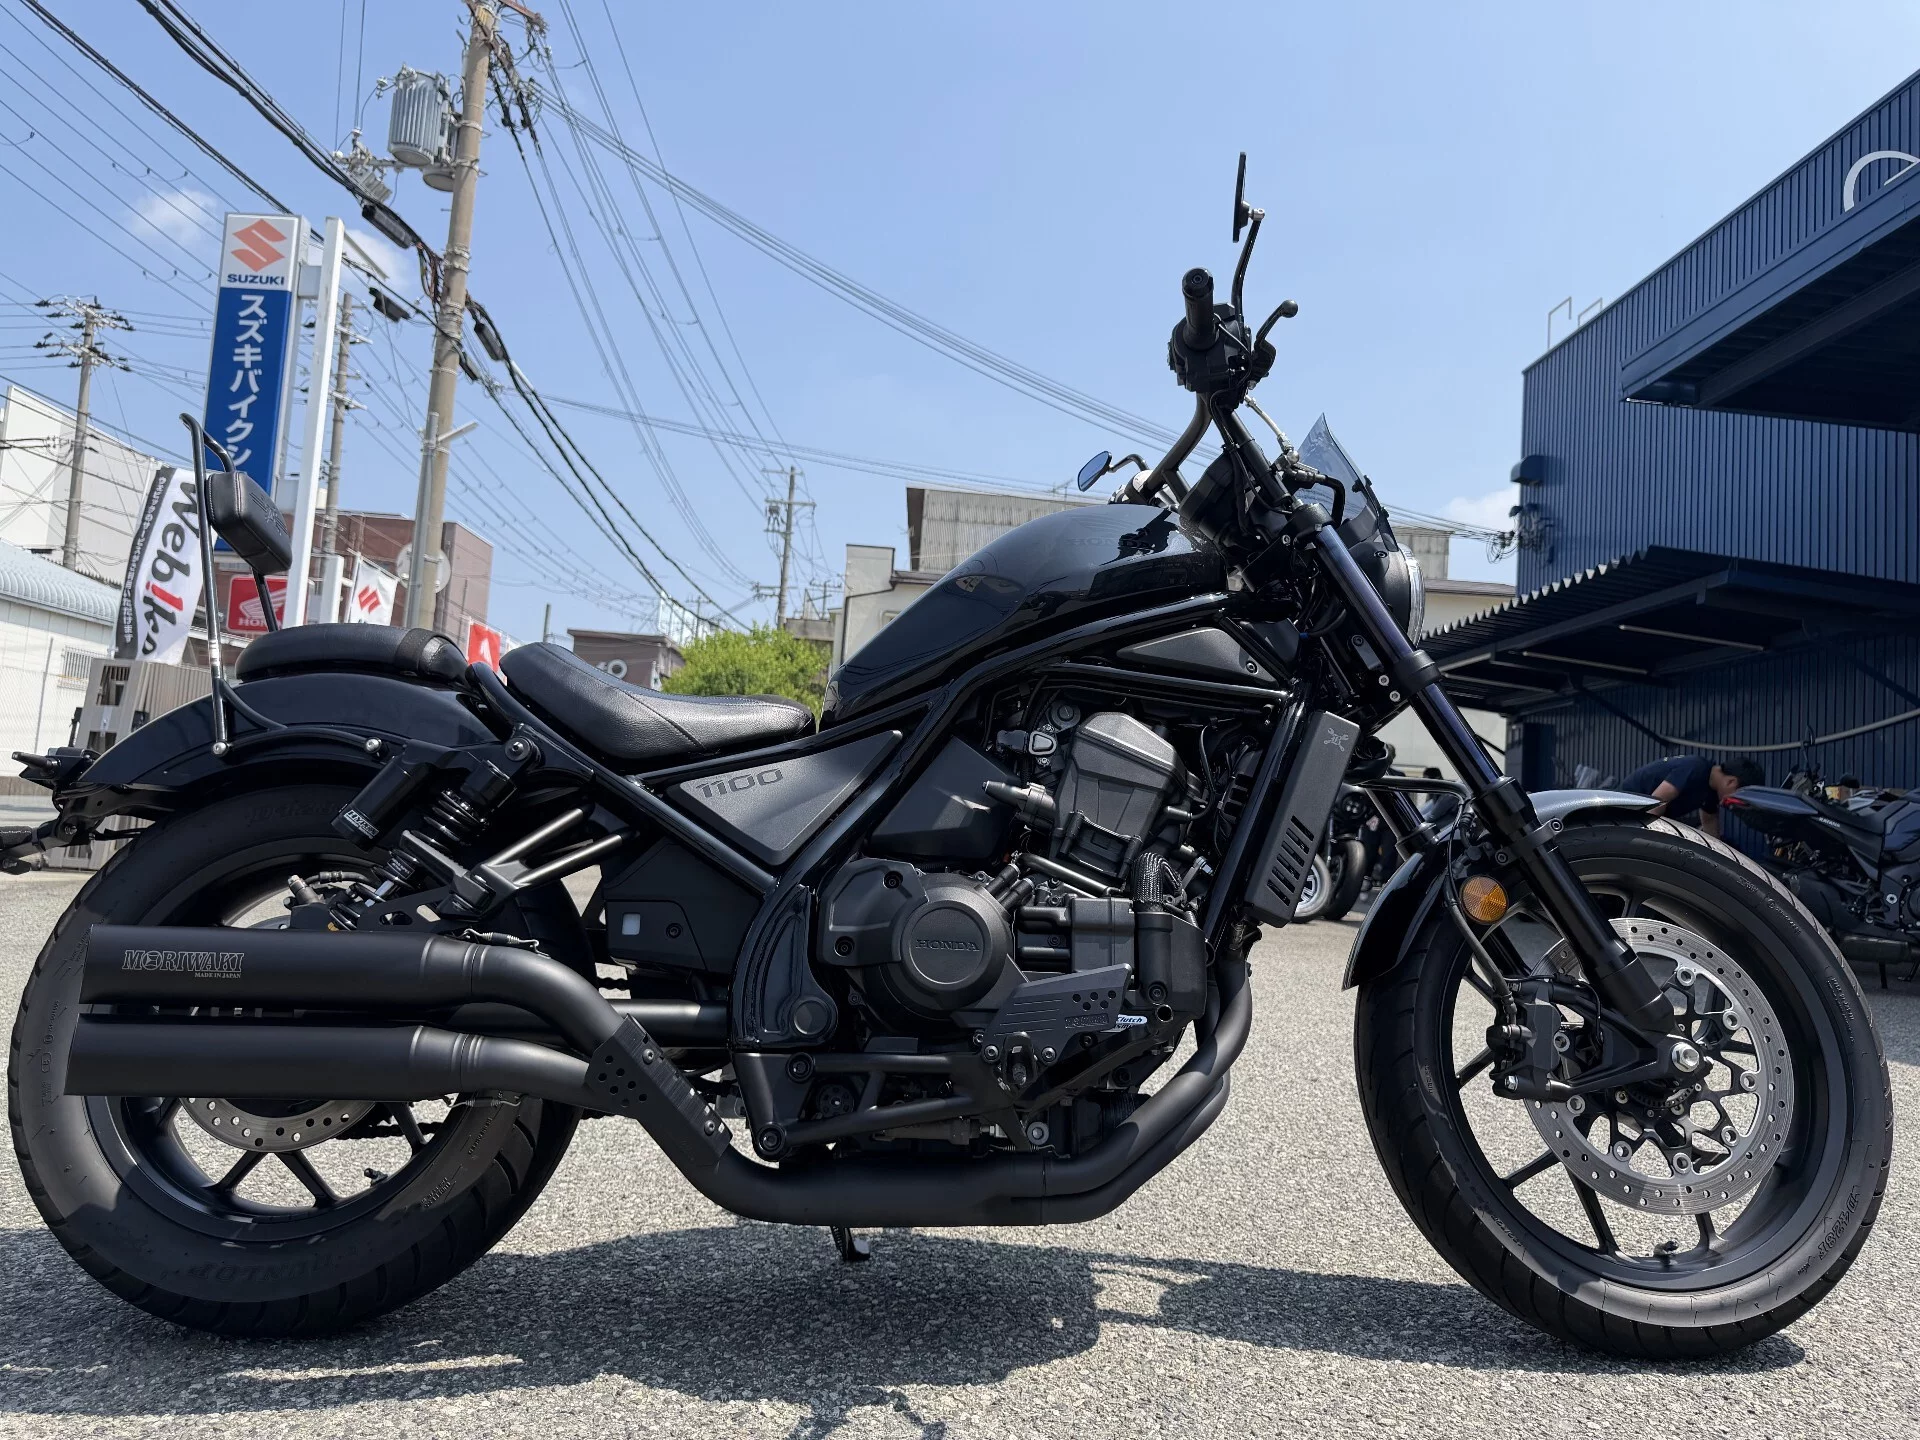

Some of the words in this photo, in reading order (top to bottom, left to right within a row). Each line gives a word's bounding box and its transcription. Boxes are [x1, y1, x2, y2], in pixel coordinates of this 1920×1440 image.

[227, 273, 285, 286] SUZUKI
[695, 768, 784, 798] 1100
[915, 939, 980, 952] HONDA
[122, 950, 245, 972] MORIWAKI
